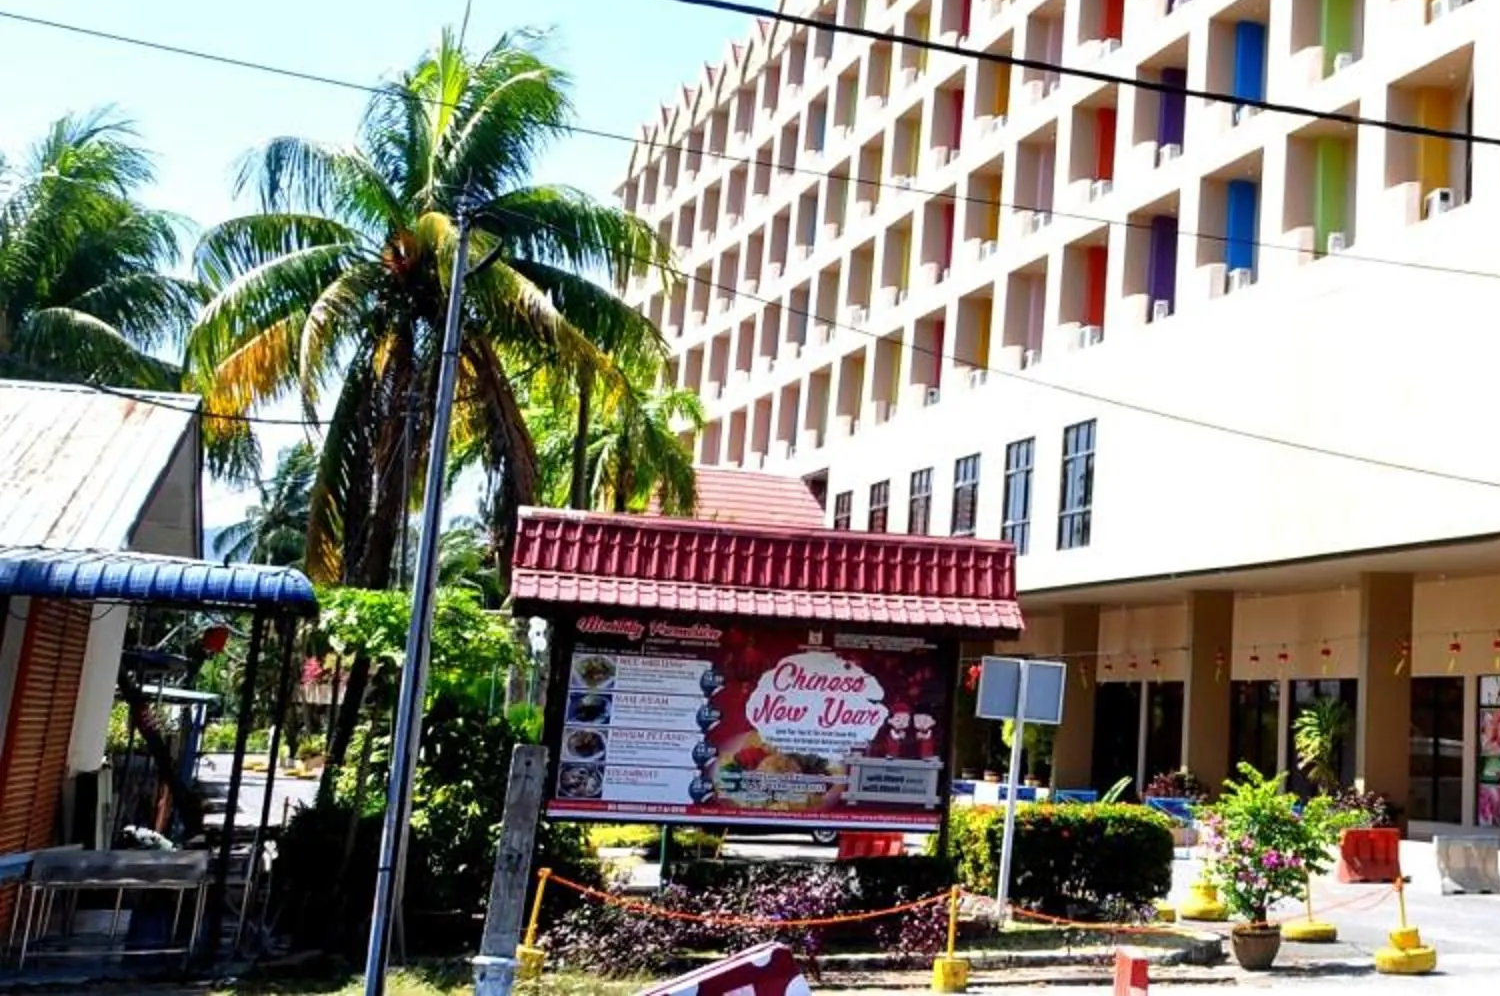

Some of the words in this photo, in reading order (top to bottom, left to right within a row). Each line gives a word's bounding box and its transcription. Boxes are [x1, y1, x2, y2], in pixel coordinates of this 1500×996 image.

[773, 661, 867, 693] Chinese
[753, 694, 809, 725] New
[818, 696, 882, 729] Year
